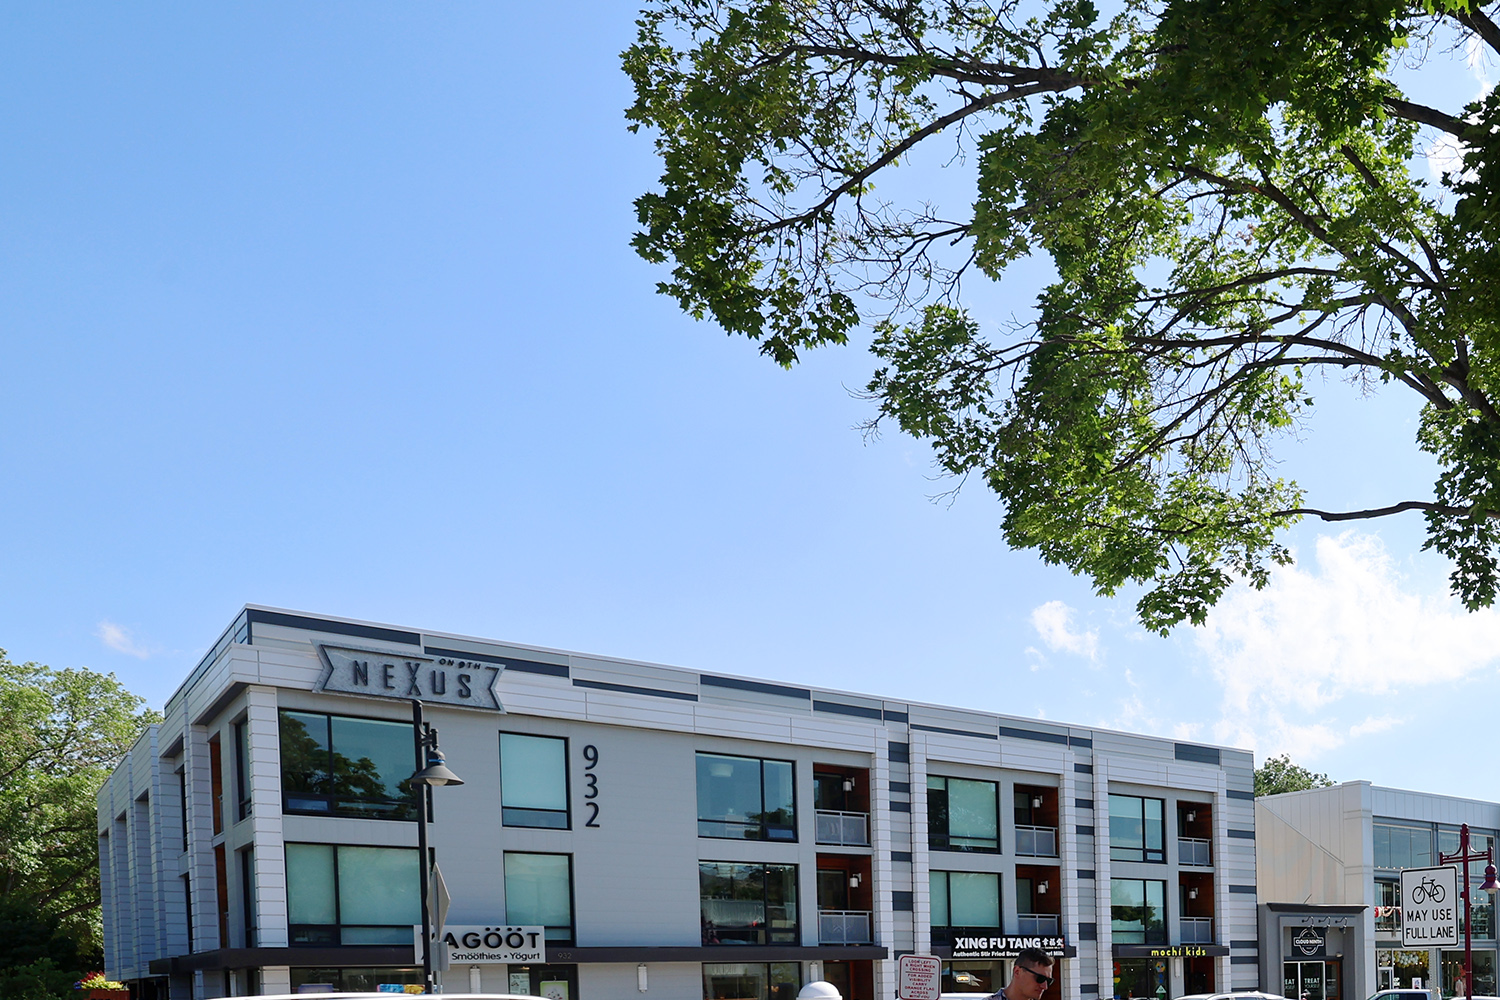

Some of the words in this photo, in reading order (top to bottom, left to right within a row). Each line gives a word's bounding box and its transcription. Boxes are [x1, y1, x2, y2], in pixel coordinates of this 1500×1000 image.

[439, 658, 454, 667] ON
[353, 660, 471, 698] NEXUS
[583, 744, 600, 828] 932
[1407, 910, 1428, 922] MAY
[1432, 909, 1452, 921] USE
[1406, 927, 1428, 939] FULL
[1430, 926, 1454, 938] LANE
[955, 938, 988, 949] XING
[989, 938, 1007, 949] FU
[1007, 938, 1041, 949] TANG
[557, 952, 572, 960] 932
[1151, 946, 1182, 956] mochi
[1185, 946, 1206, 956] kids
[452, 952, 501, 961] Smööthies
[509, 952, 540, 962] Yögurt
